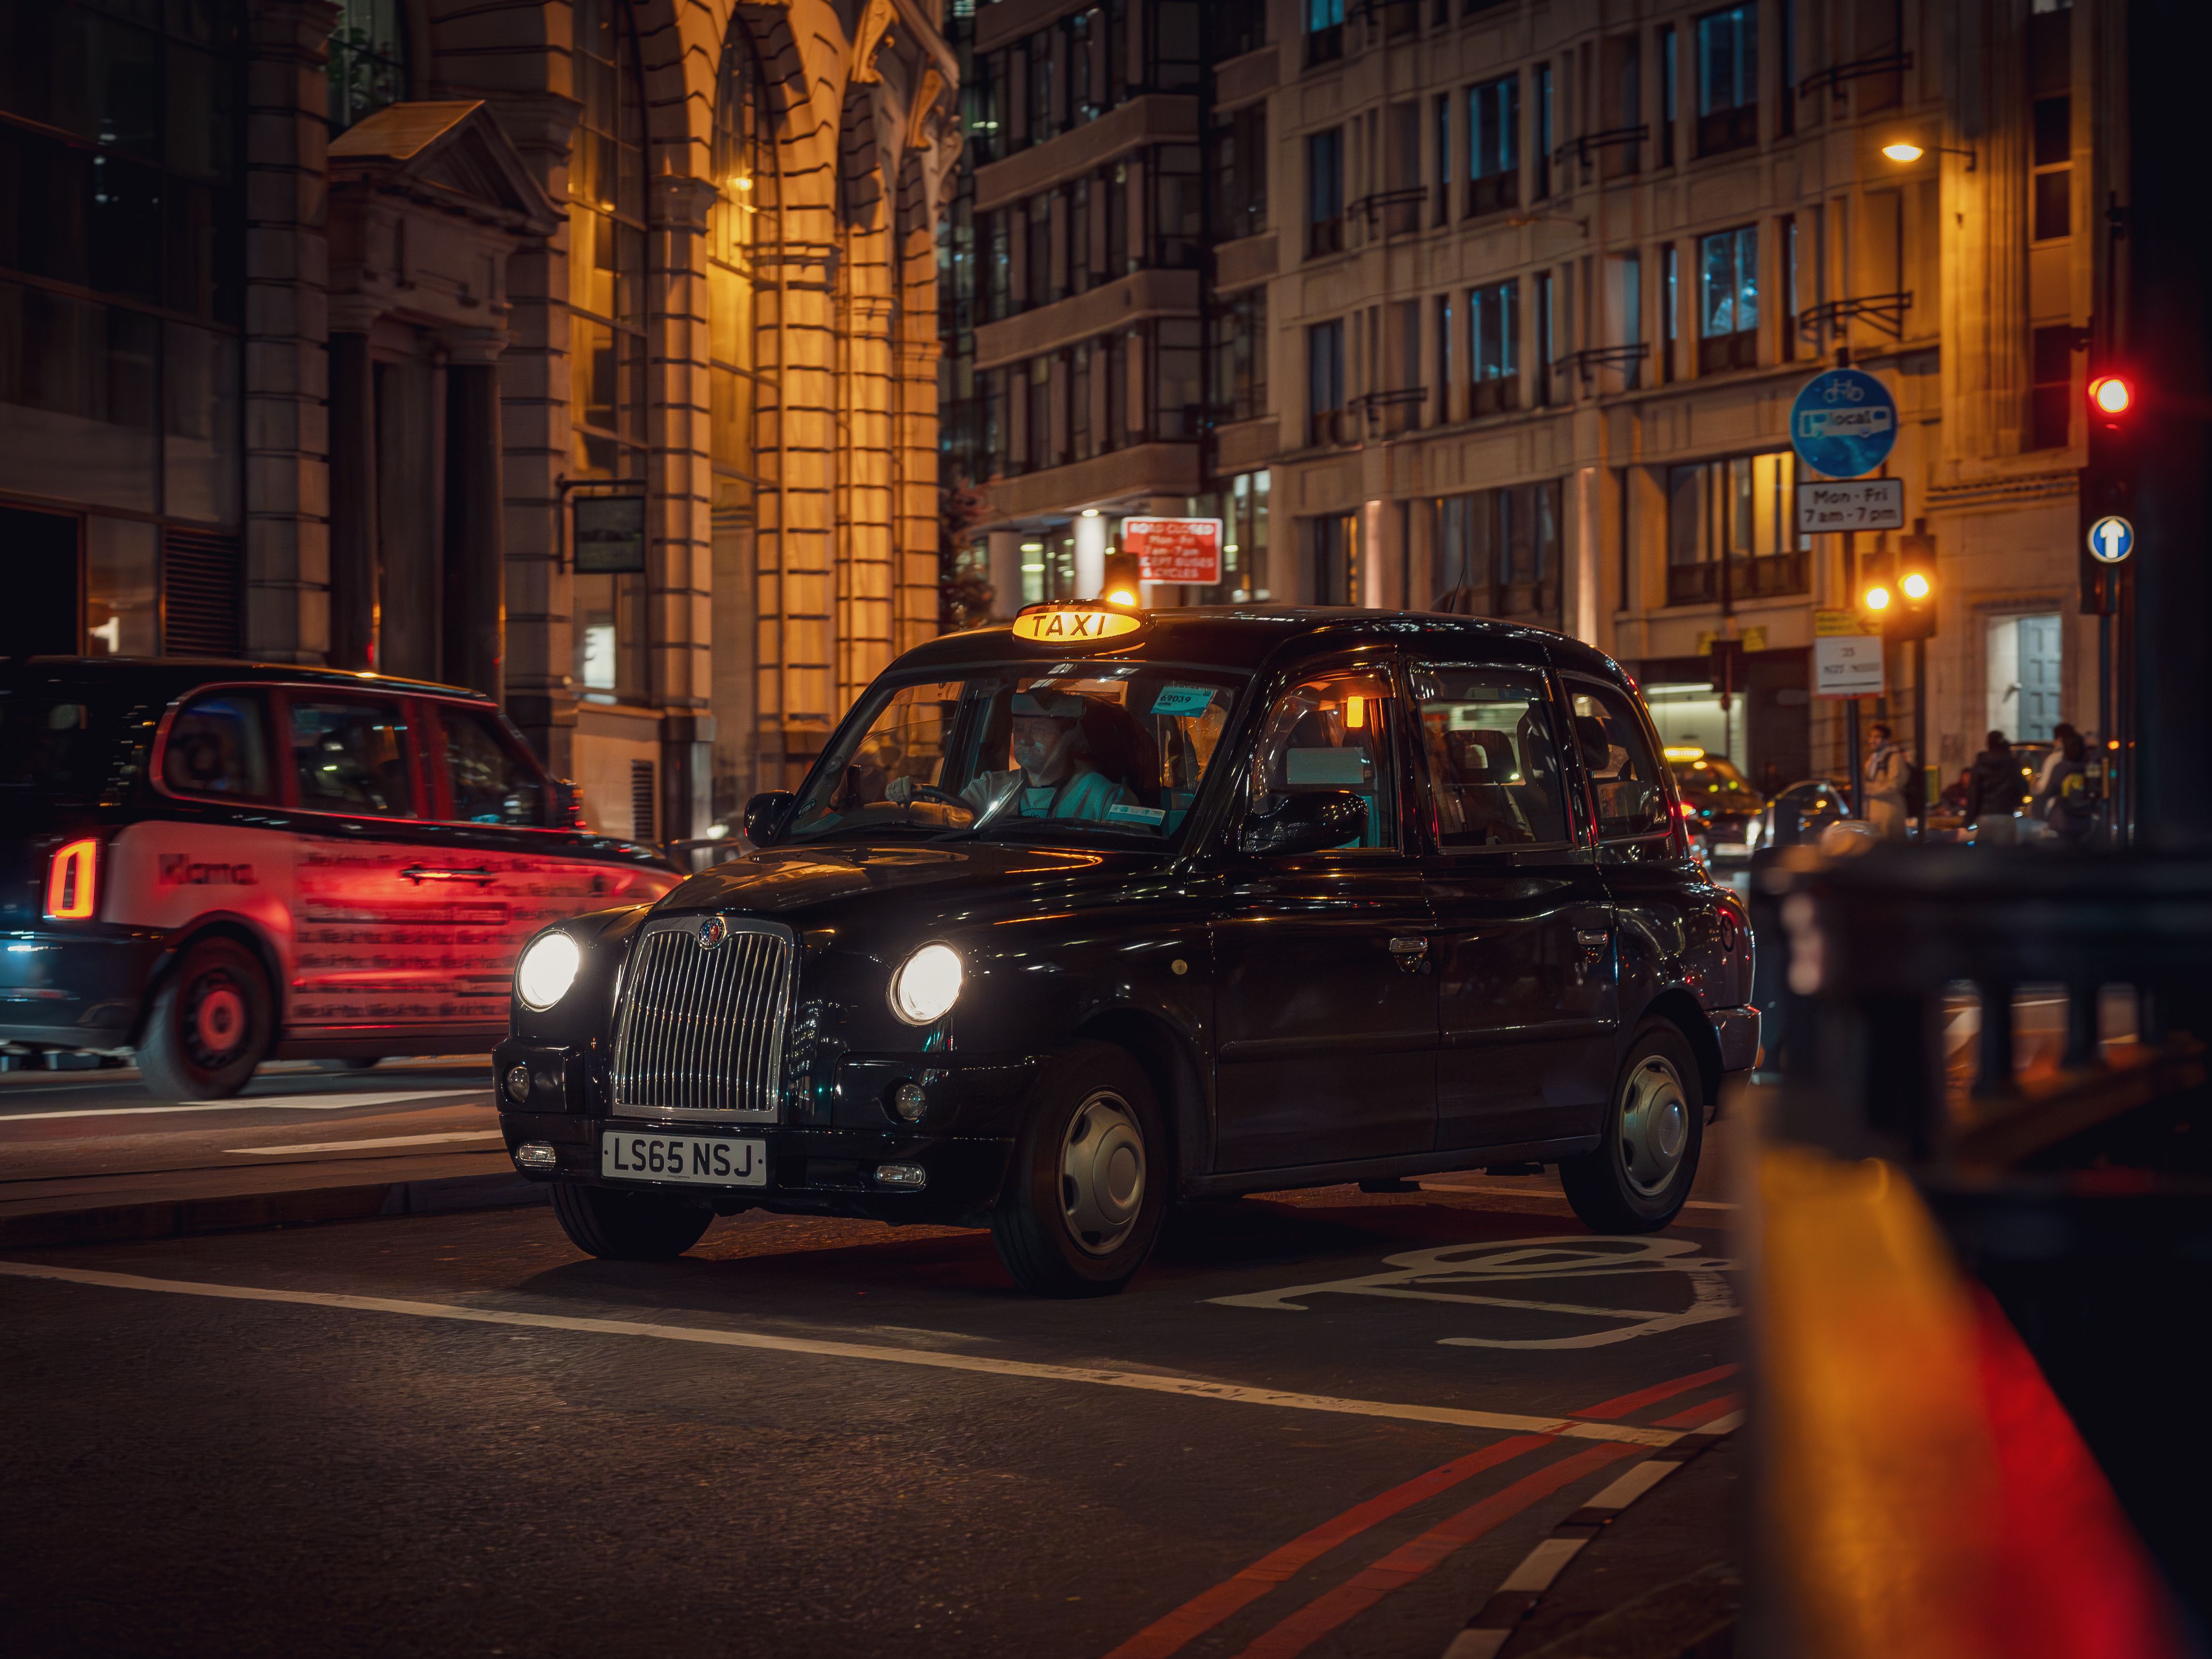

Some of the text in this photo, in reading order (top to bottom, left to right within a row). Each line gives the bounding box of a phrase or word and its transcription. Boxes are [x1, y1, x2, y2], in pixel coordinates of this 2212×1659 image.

[1814, 491, 1850, 504] Mon
[1864, 487, 1888, 501] Fri
[1032, 615, 1107, 637] TAXI
[614, 1137, 752, 1177] LS65 NSJ
